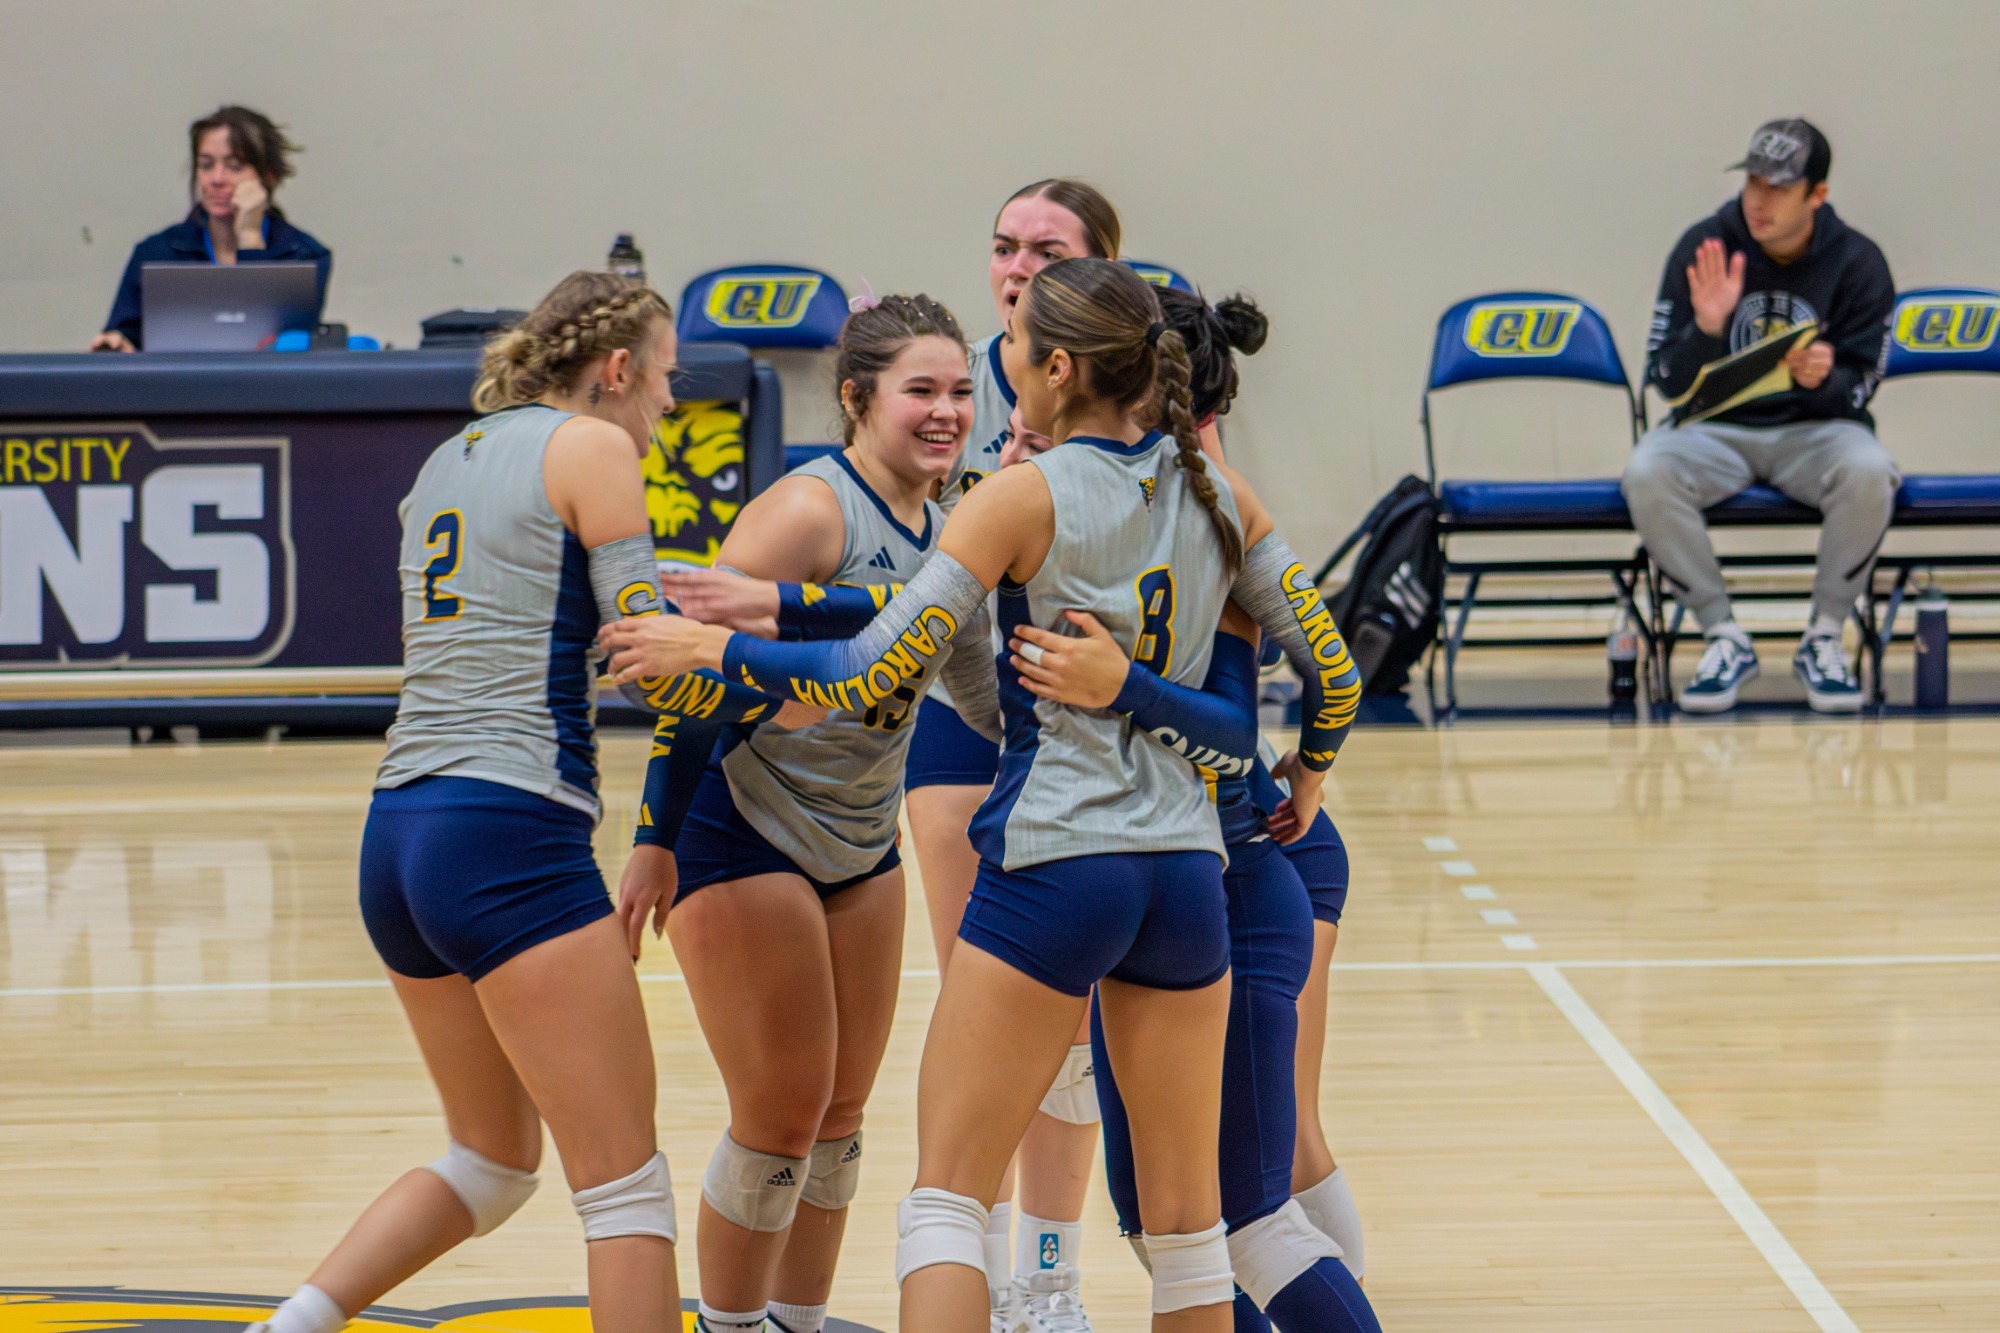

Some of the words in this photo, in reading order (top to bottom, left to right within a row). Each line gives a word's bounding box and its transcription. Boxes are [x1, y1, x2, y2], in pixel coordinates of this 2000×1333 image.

[704, 274, 820, 328] CU
[1464, 302, 1583, 357] CU
[1891, 297, 2000, 353] CU
[0, 438, 131, 483] RSITY
[421, 507, 464, 623] 2
[789, 605, 958, 713] CAROLINA
[1131, 563, 1177, 678] 8
[1280, 562, 1363, 730] CAROLINA
